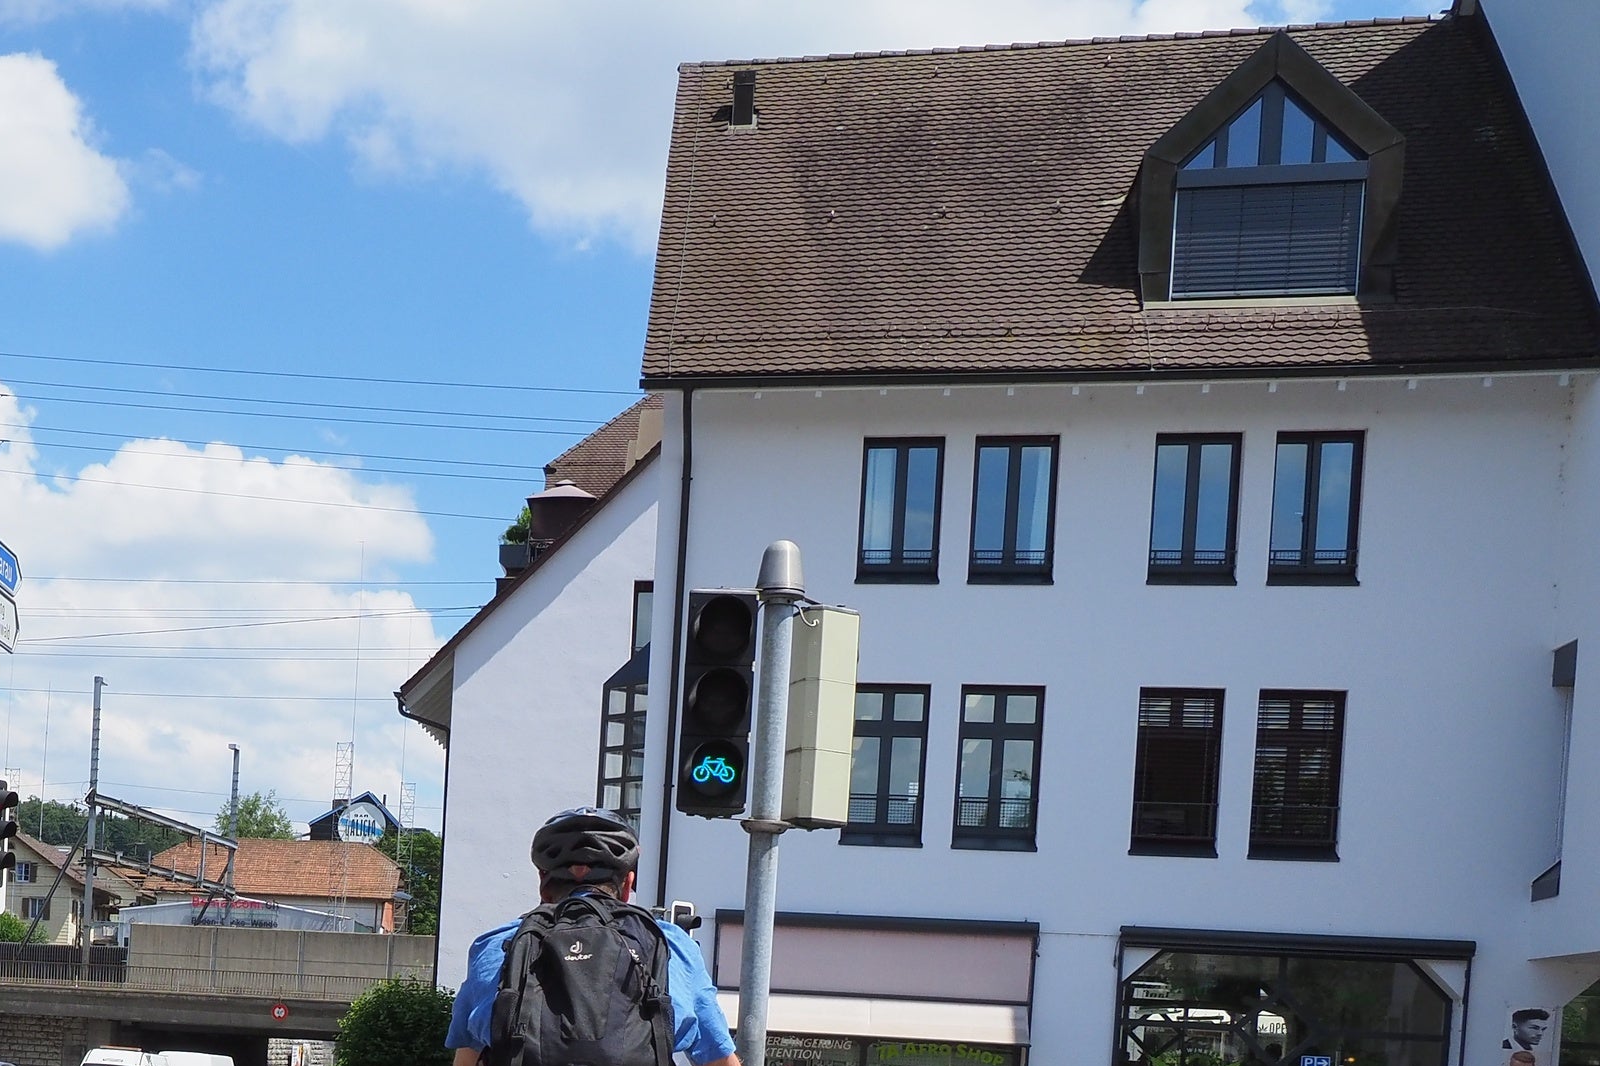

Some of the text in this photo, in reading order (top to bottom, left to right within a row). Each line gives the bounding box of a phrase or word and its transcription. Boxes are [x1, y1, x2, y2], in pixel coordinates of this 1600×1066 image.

[564, 953, 593, 961] deuter
[1269, 1022, 1287, 1034] OPE
[956, 1043, 1004, 1066] SHOP
[1304, 1058, 1313, 1066] P
